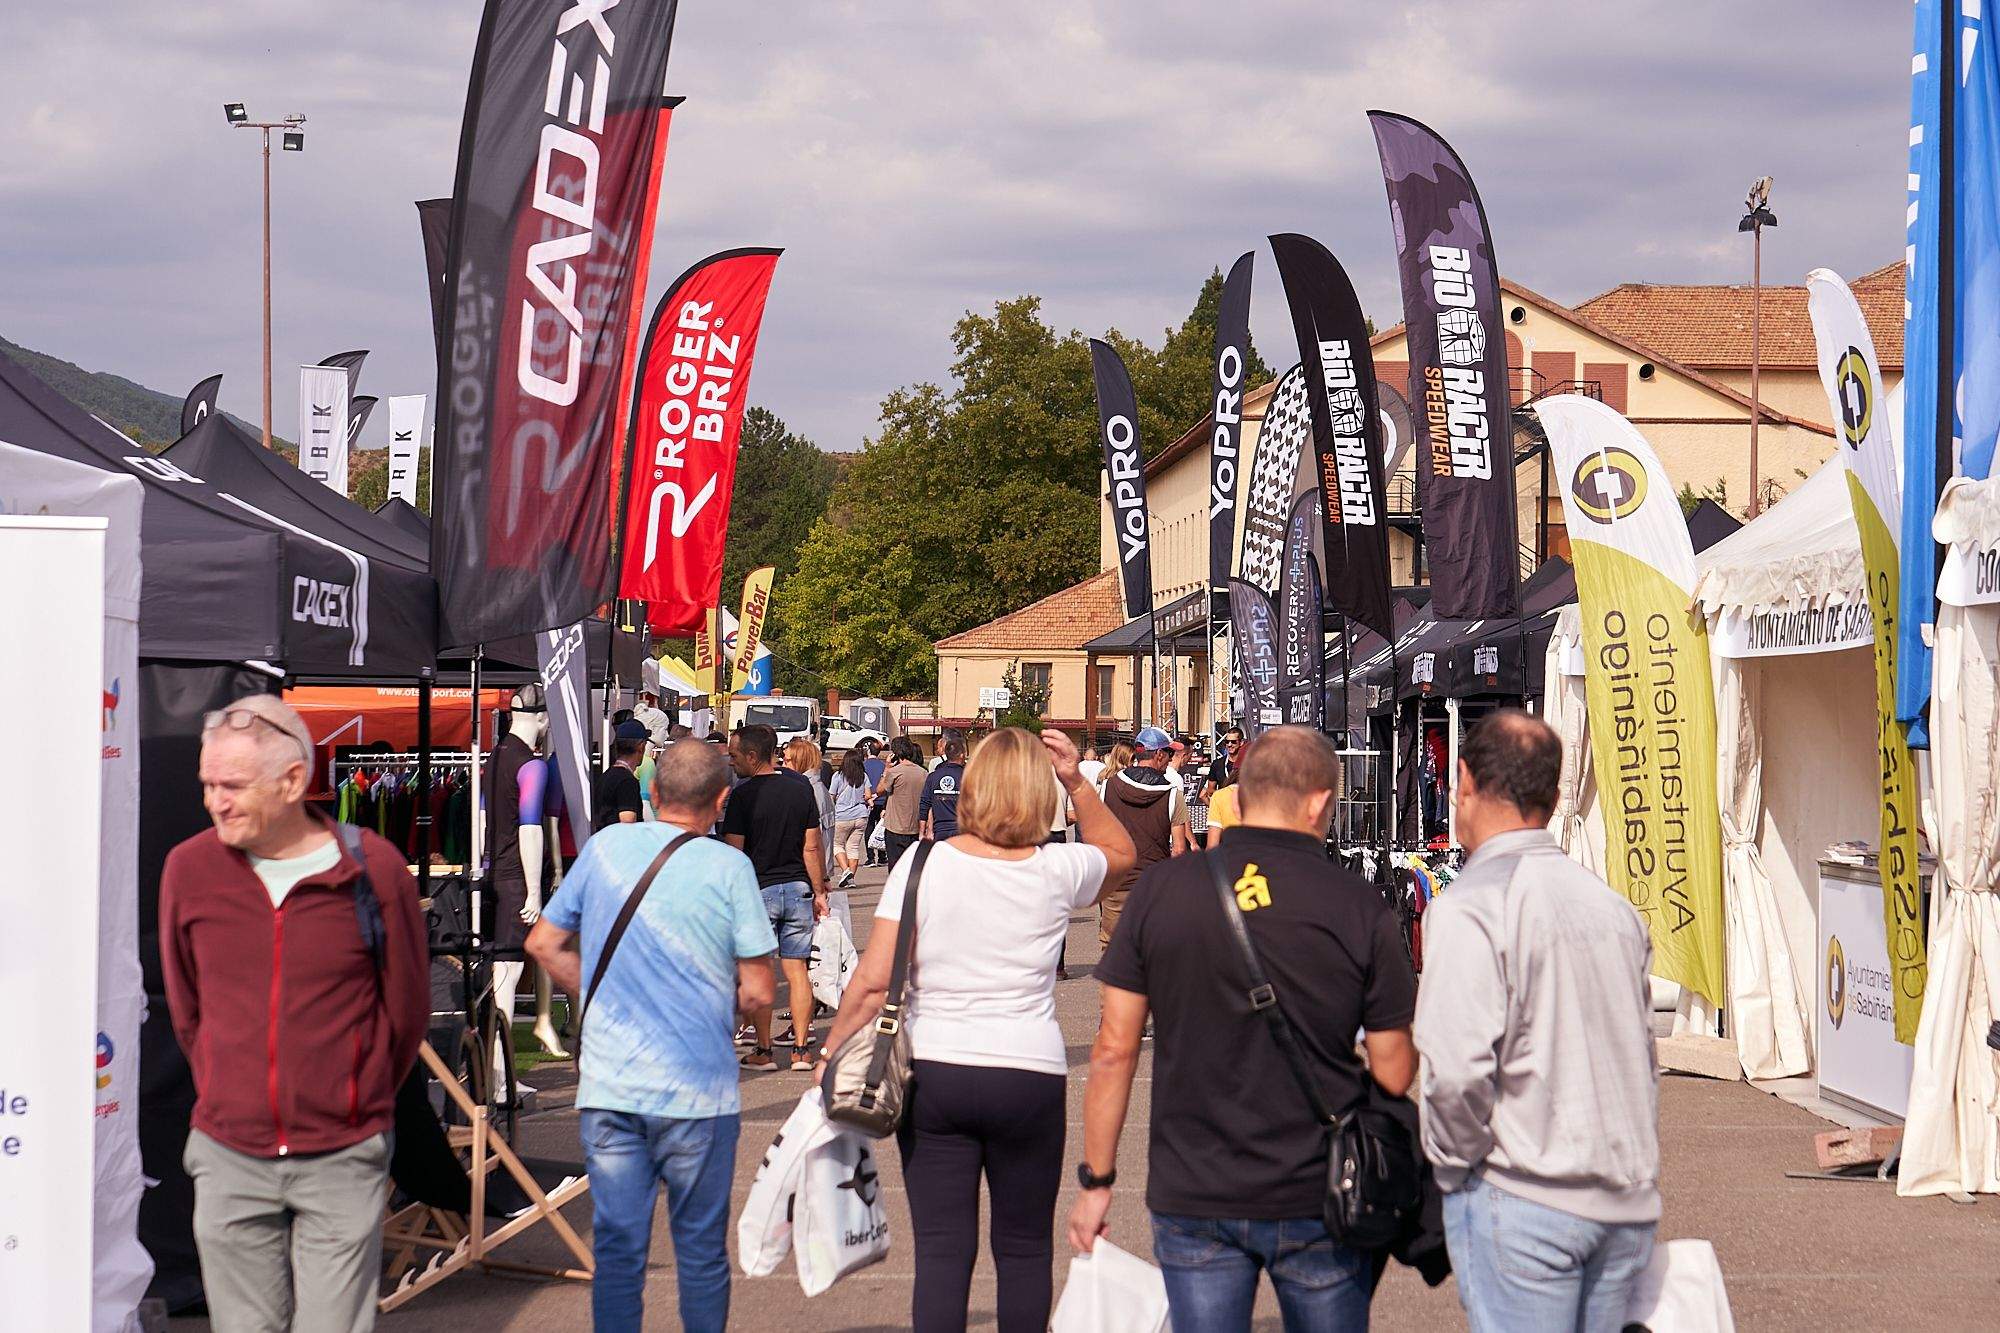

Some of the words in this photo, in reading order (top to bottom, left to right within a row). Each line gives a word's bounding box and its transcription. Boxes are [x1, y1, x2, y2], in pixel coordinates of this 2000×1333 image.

[518, 0, 621, 405] CADEX
[654, 300, 714, 469] ROGER
[1424, 366, 1452, 477] SPEEDWEAR
[309, 403, 332, 482] OBIK
[1210, 345, 1243, 521] YoPRO
[1106, 414, 1147, 564] YoPRO
[1322, 452, 1341, 524] SPEEDWEAR
[292, 575, 350, 628] CADEX
[737, 583, 768, 674] PowerBar
[1825, 605, 1843, 643] DE
[1847, 959, 1892, 991] Ayuntamie
